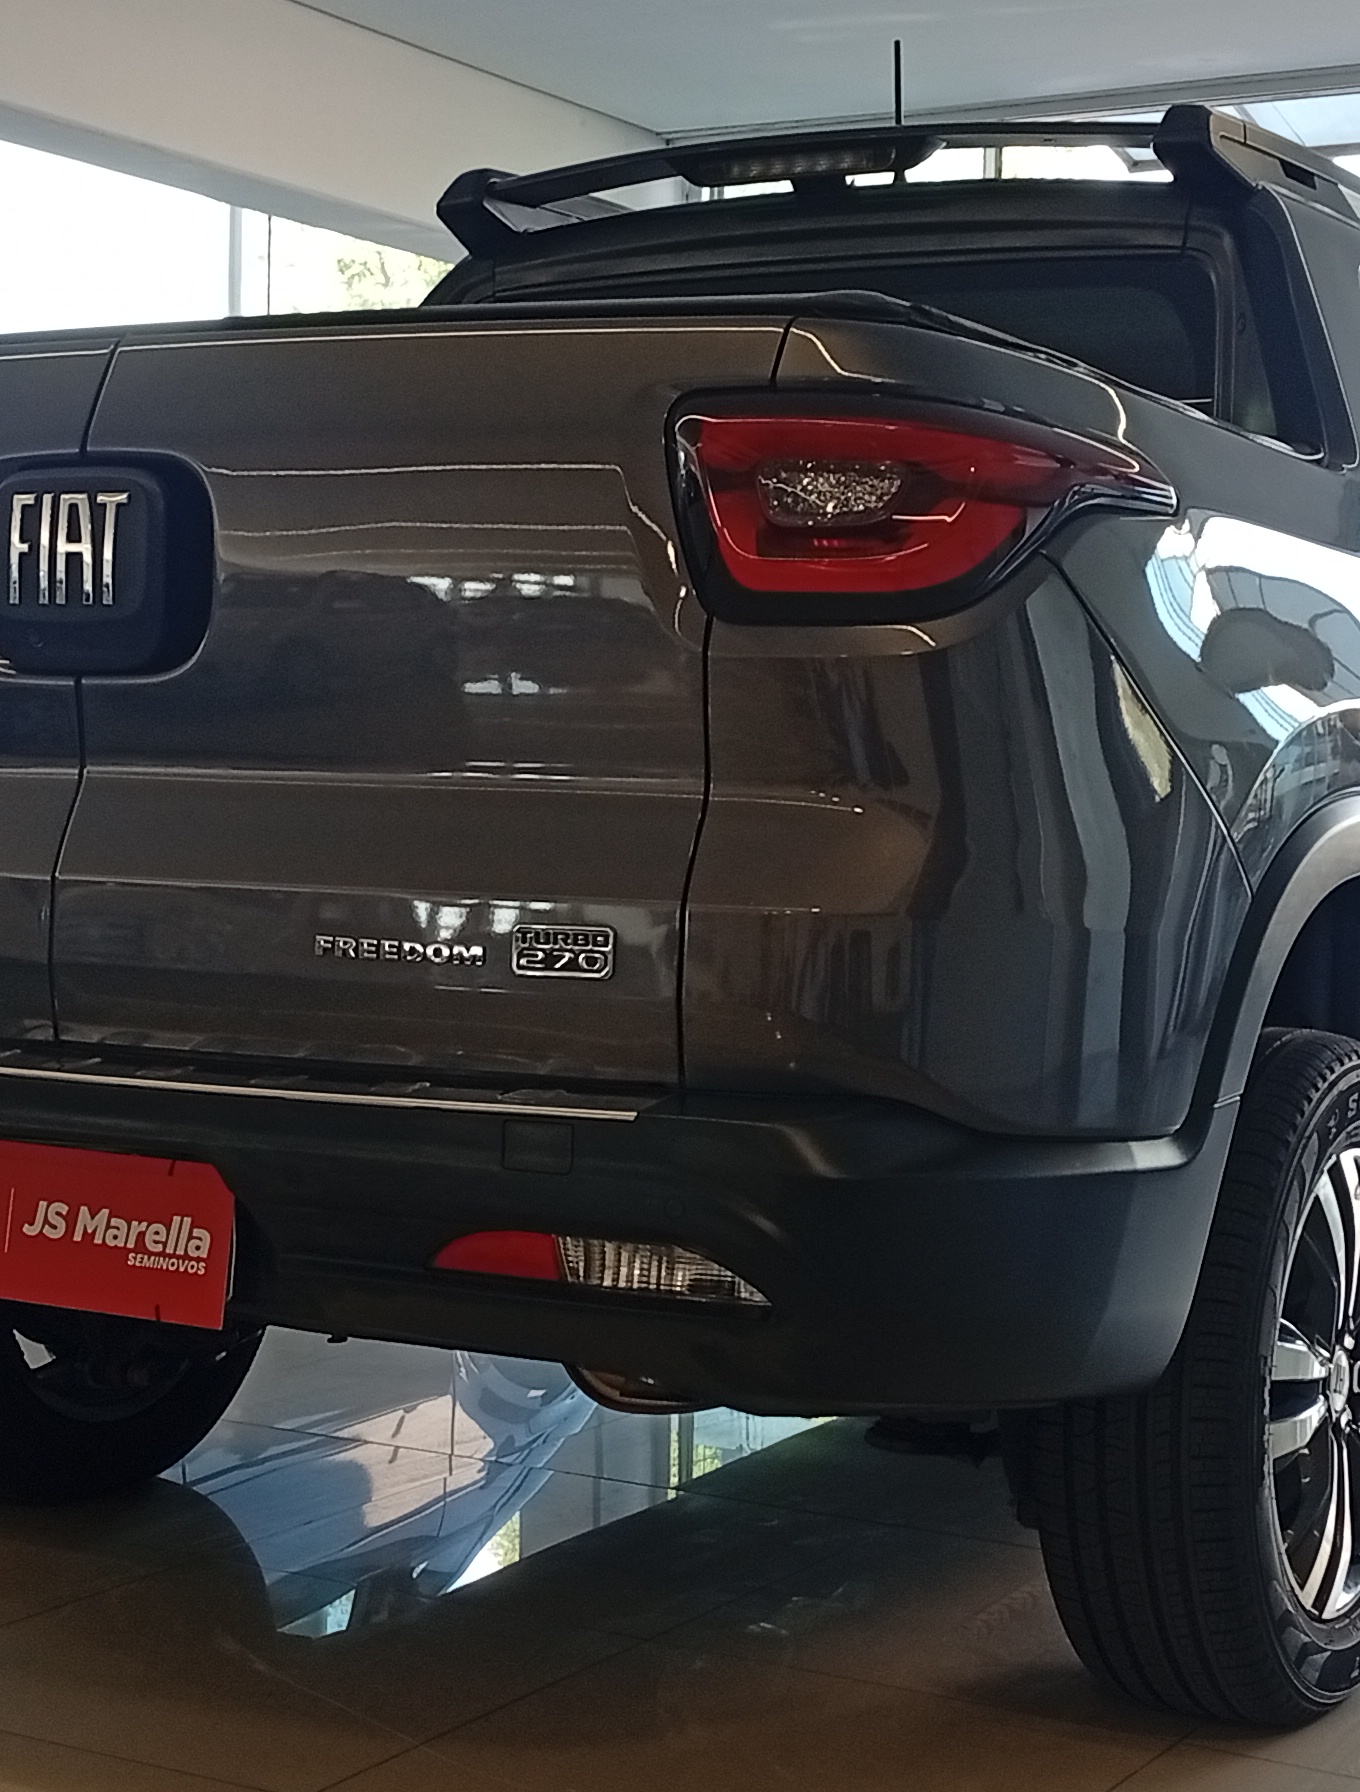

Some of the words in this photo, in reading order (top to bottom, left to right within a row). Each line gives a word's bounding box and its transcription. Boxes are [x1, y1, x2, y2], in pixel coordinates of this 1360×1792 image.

[9, 492, 130, 605] FIAT
[314, 935, 484, 966] FREEDOM
[516, 929, 609, 949] TURBO
[519, 950, 605, 971] 270
[22, 1200, 69, 1239] JS
[73, 1206, 211, 1259] Marella
[127, 1252, 206, 1275] SEMINOVOS
